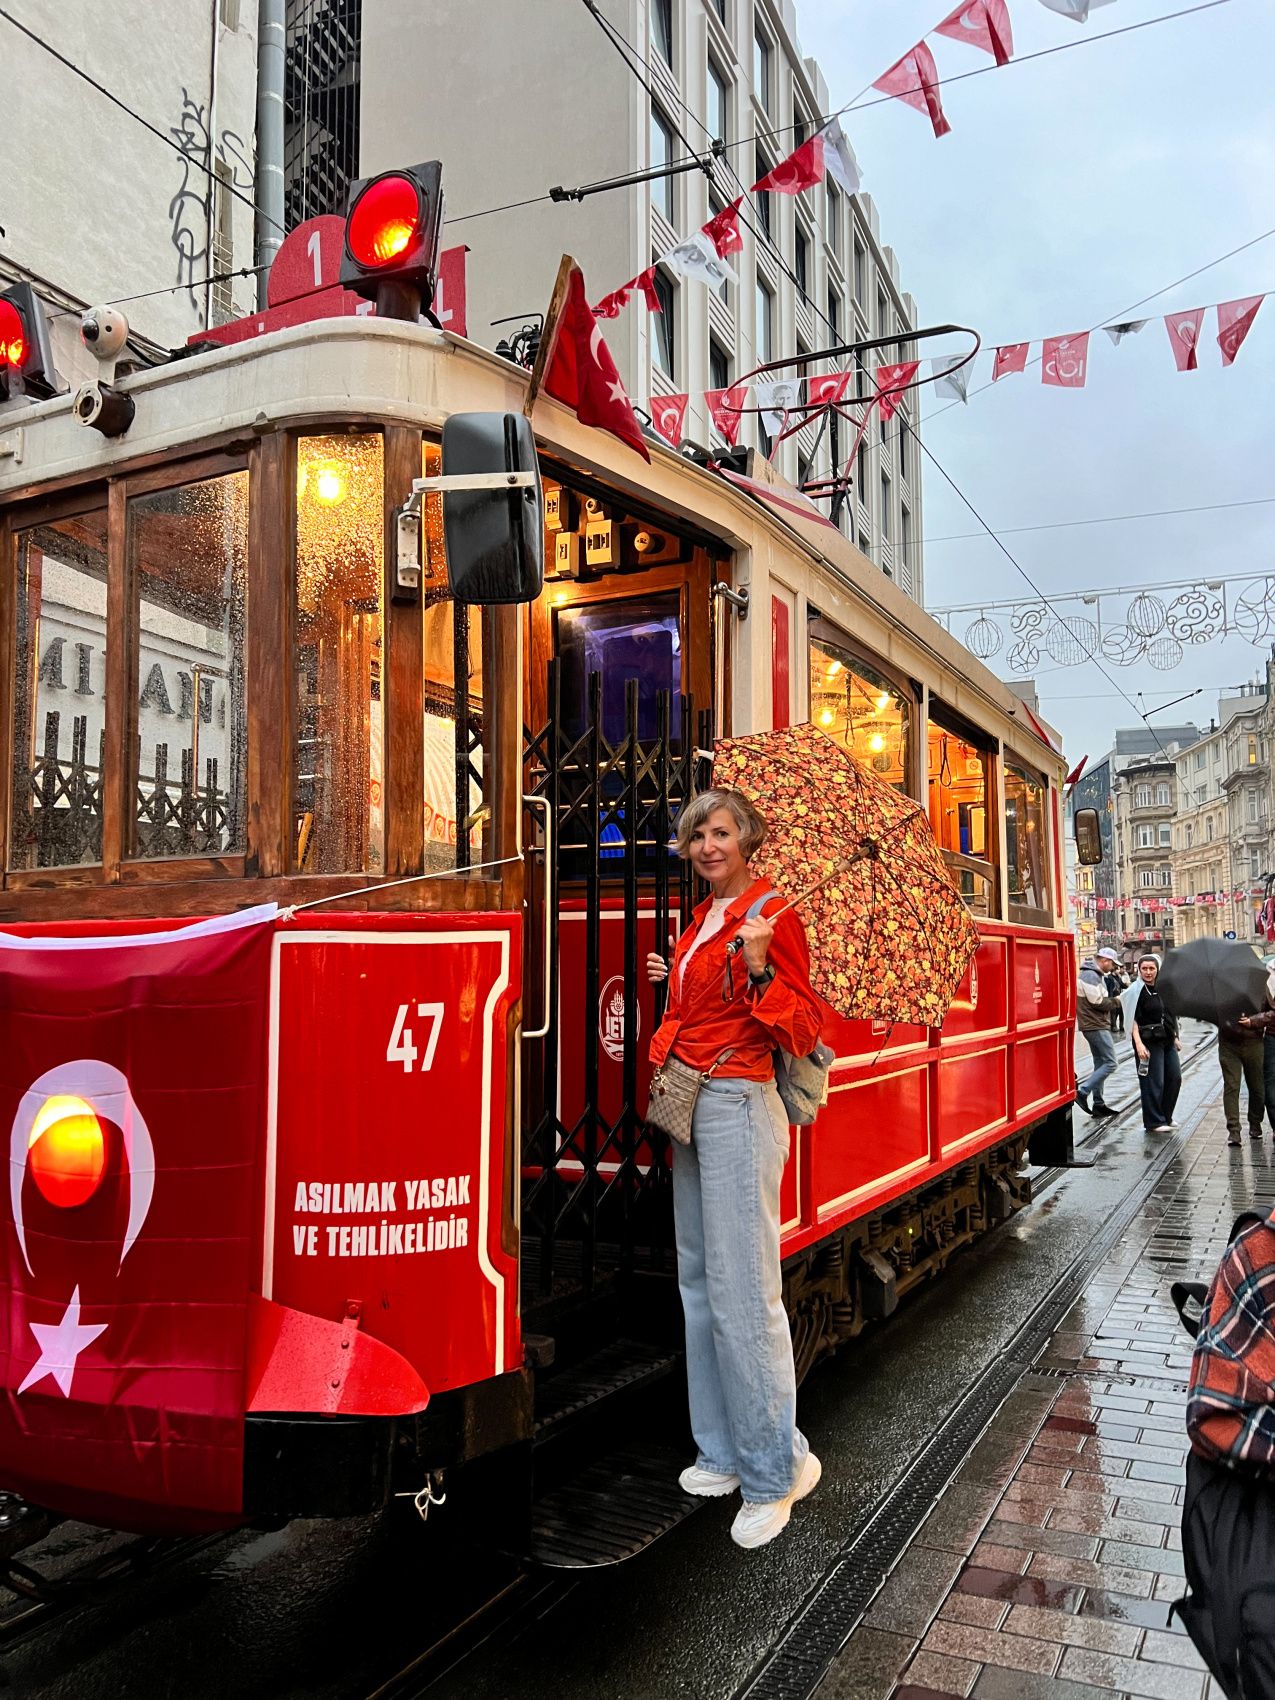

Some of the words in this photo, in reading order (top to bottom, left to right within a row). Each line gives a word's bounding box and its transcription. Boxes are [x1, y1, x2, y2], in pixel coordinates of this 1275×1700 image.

[307, 230, 322, 287] 1
[386, 1002, 445, 1073] 47
[294, 1181, 397, 1214] ASILMAK
[404, 1174, 470, 1211] YASAK
[293, 1225, 318, 1256] VE
[326, 1213, 468, 1257] TEHLİKELİDİR
